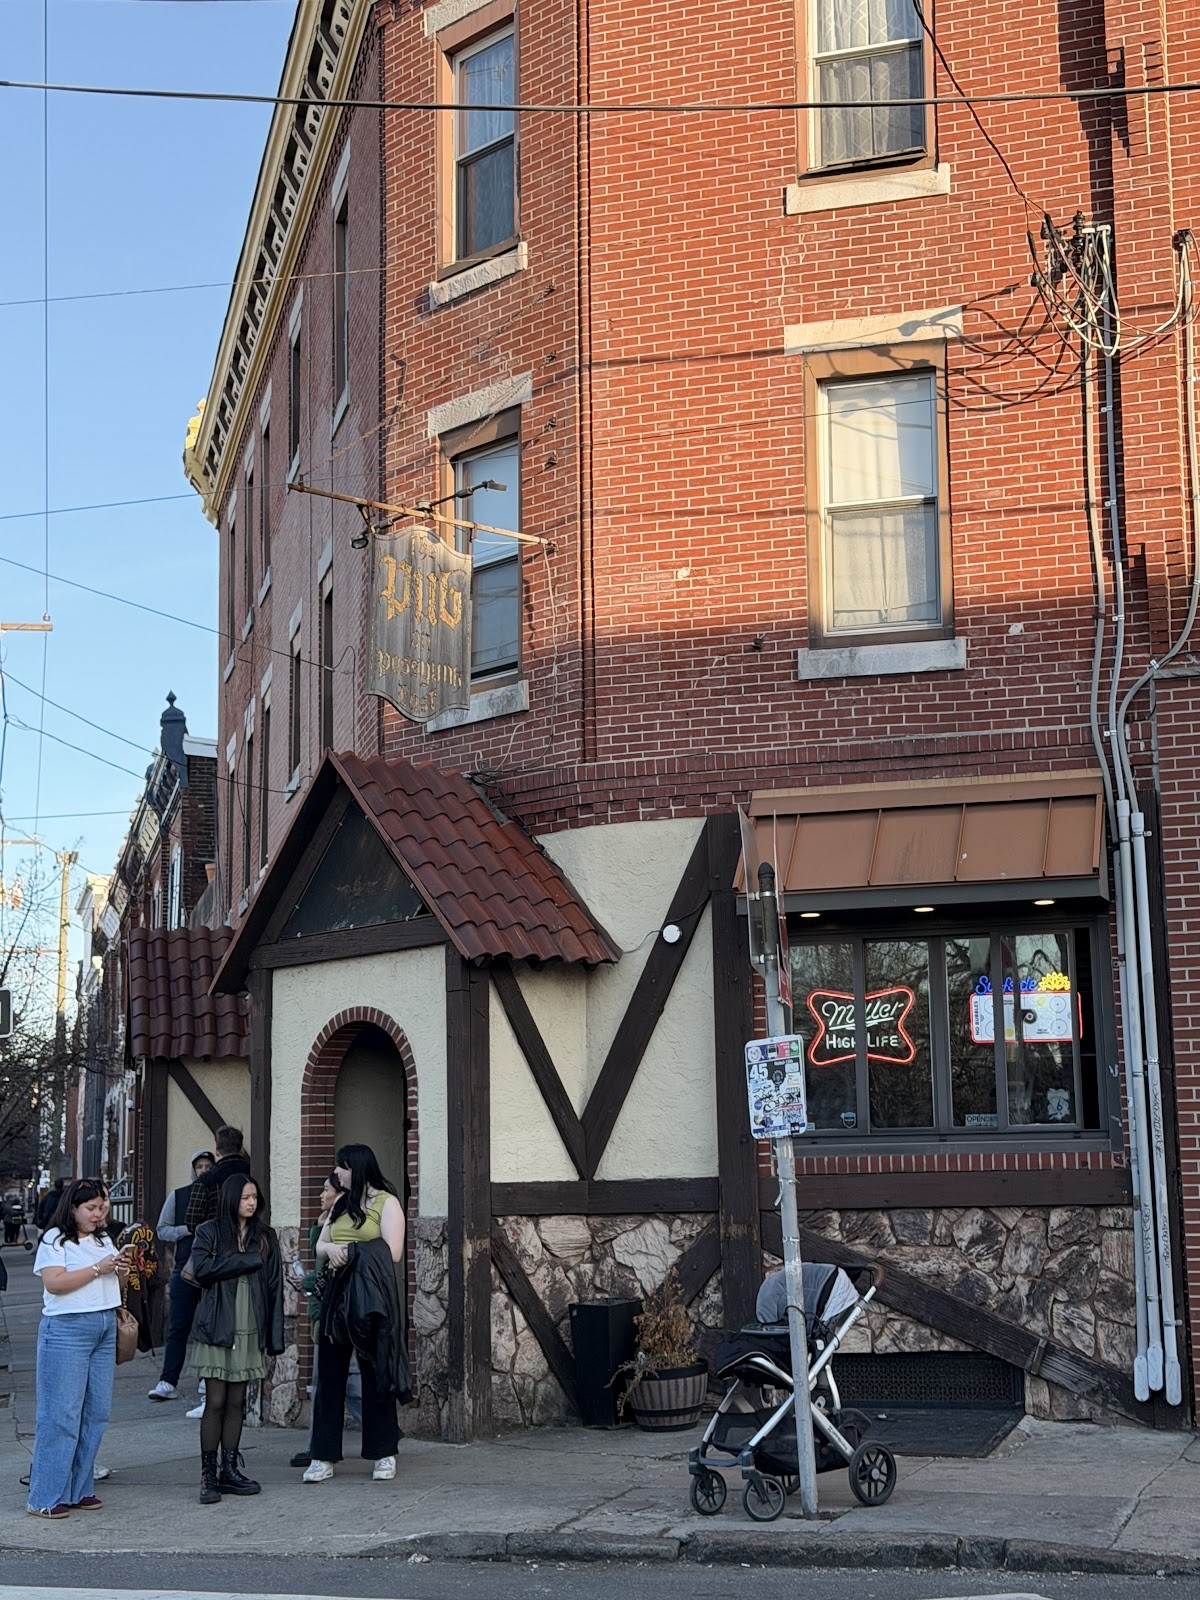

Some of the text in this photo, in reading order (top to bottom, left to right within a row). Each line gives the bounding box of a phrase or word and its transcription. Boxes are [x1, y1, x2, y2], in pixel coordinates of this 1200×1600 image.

[822, 1000, 904, 1026] Mller
[867, 1032, 899, 1047] LIFE
[750, 1063, 768, 1081] 45
